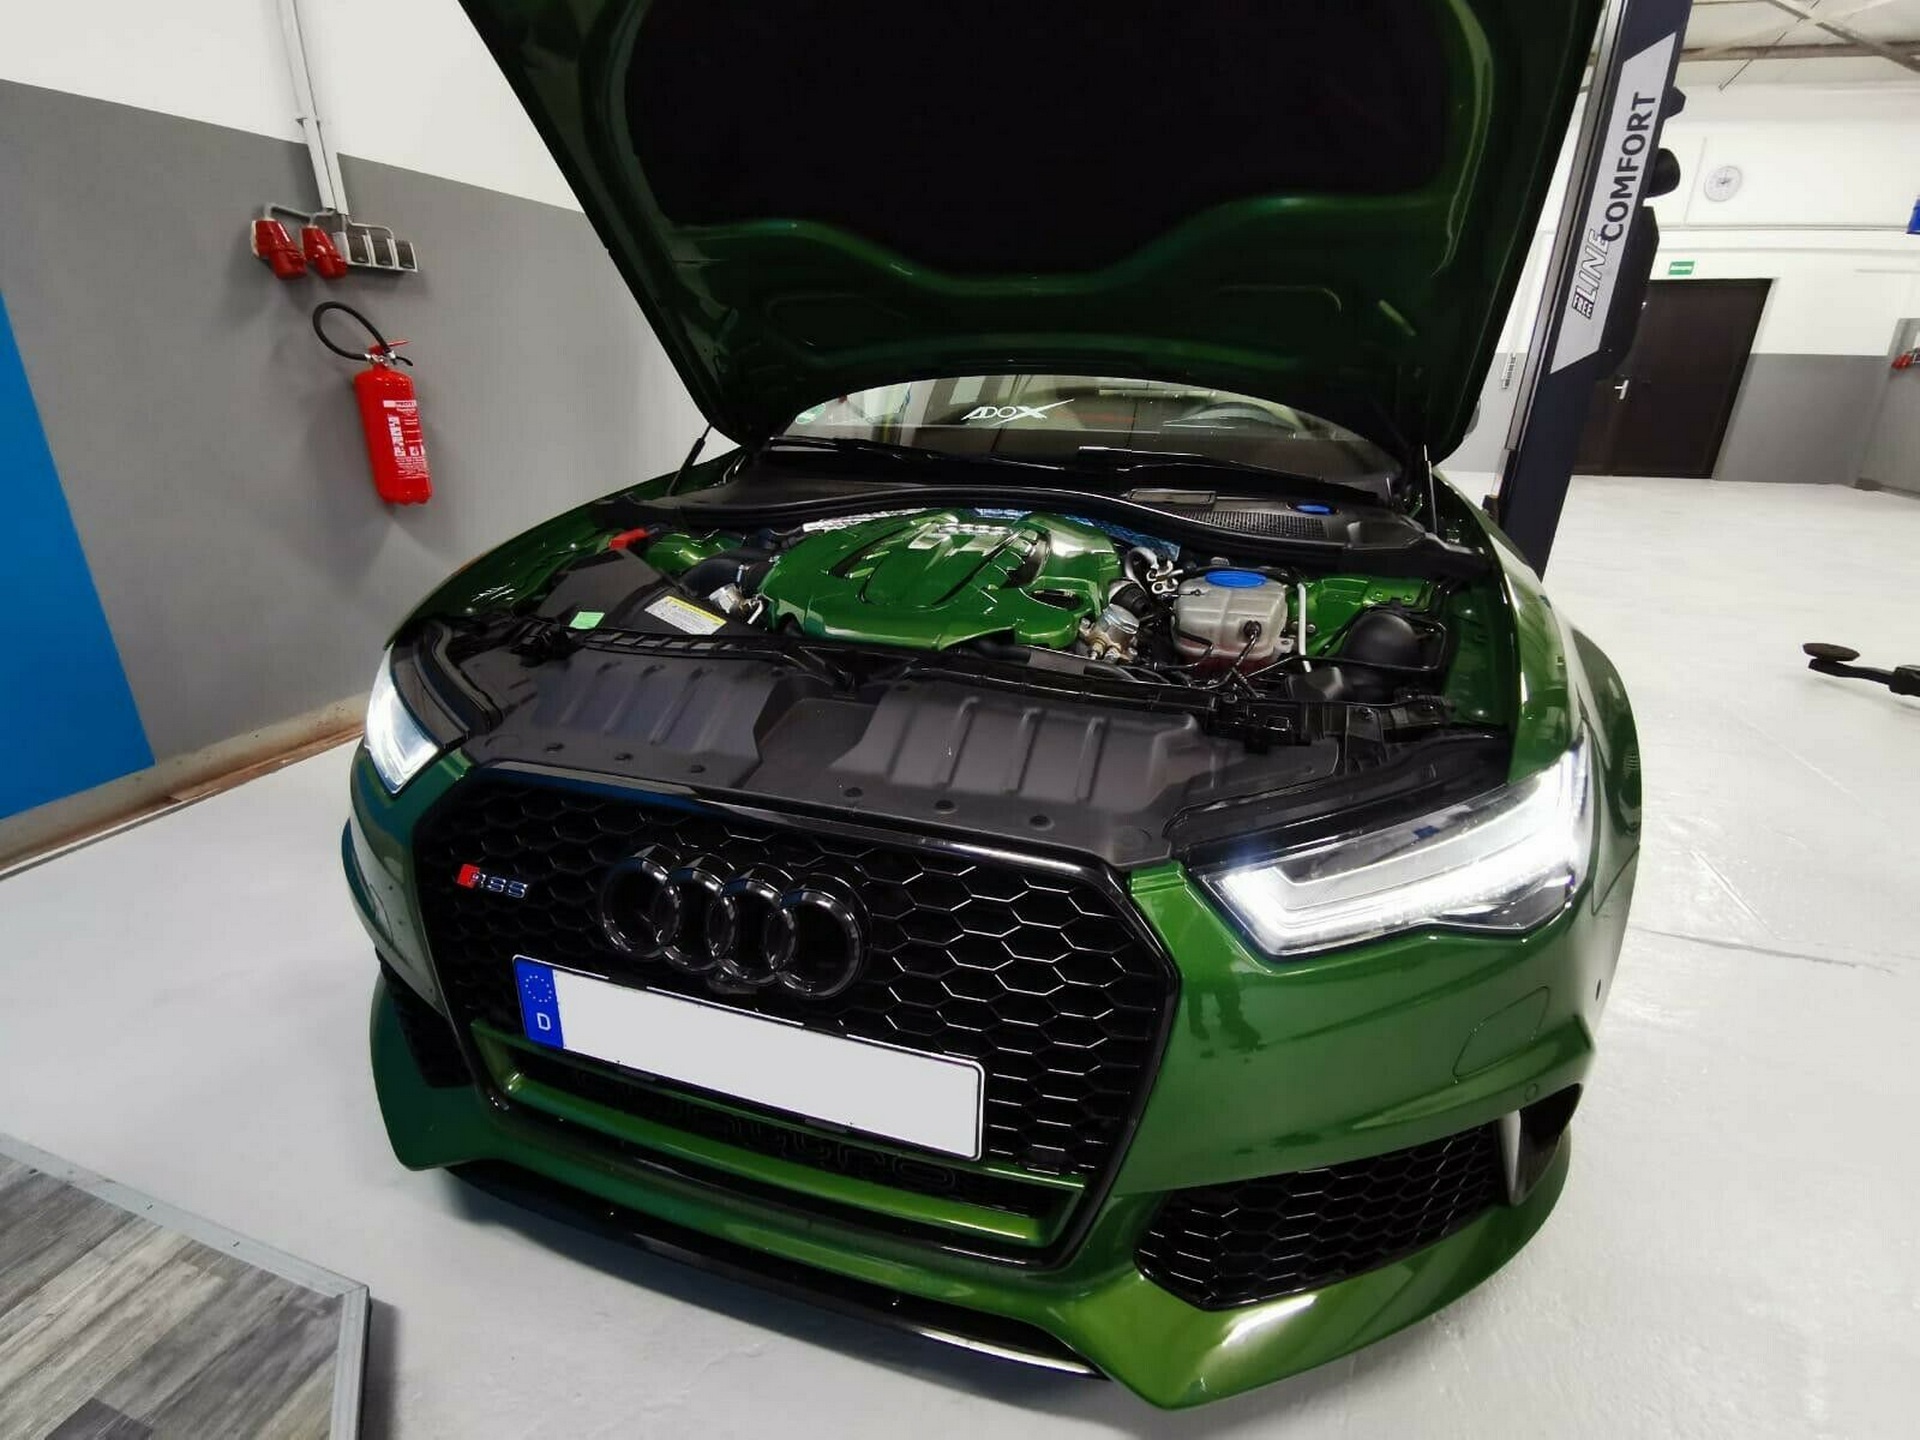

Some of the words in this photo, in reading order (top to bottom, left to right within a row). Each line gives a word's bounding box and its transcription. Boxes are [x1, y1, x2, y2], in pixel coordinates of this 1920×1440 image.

[1576, 228, 1610, 304] LINE
[1600, 92, 1656, 242] COMFORT
[537, 1012, 552, 1031] D
